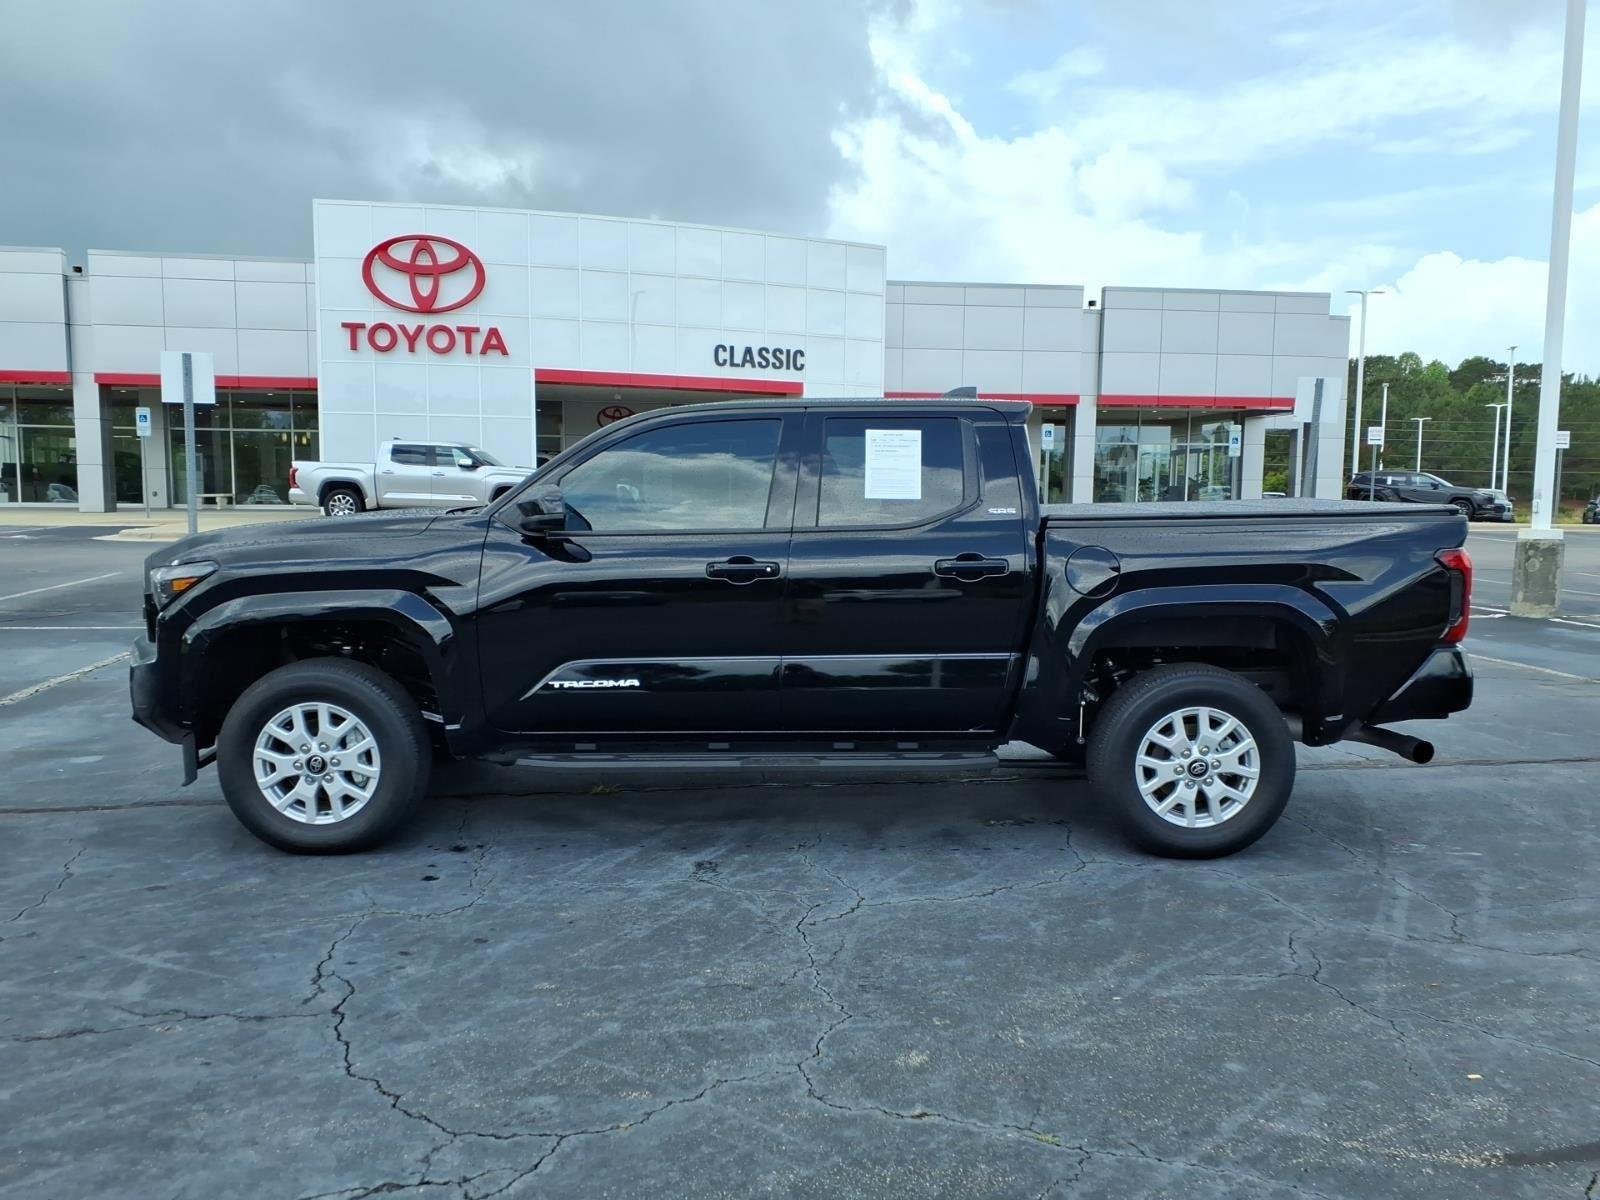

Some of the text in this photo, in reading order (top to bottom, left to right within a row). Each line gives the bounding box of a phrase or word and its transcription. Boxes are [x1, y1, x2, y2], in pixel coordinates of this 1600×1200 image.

[341, 322, 509, 356] TOYOTA
[714, 344, 805, 371] CLASSIC
[548, 679, 640, 688] TACOMA
